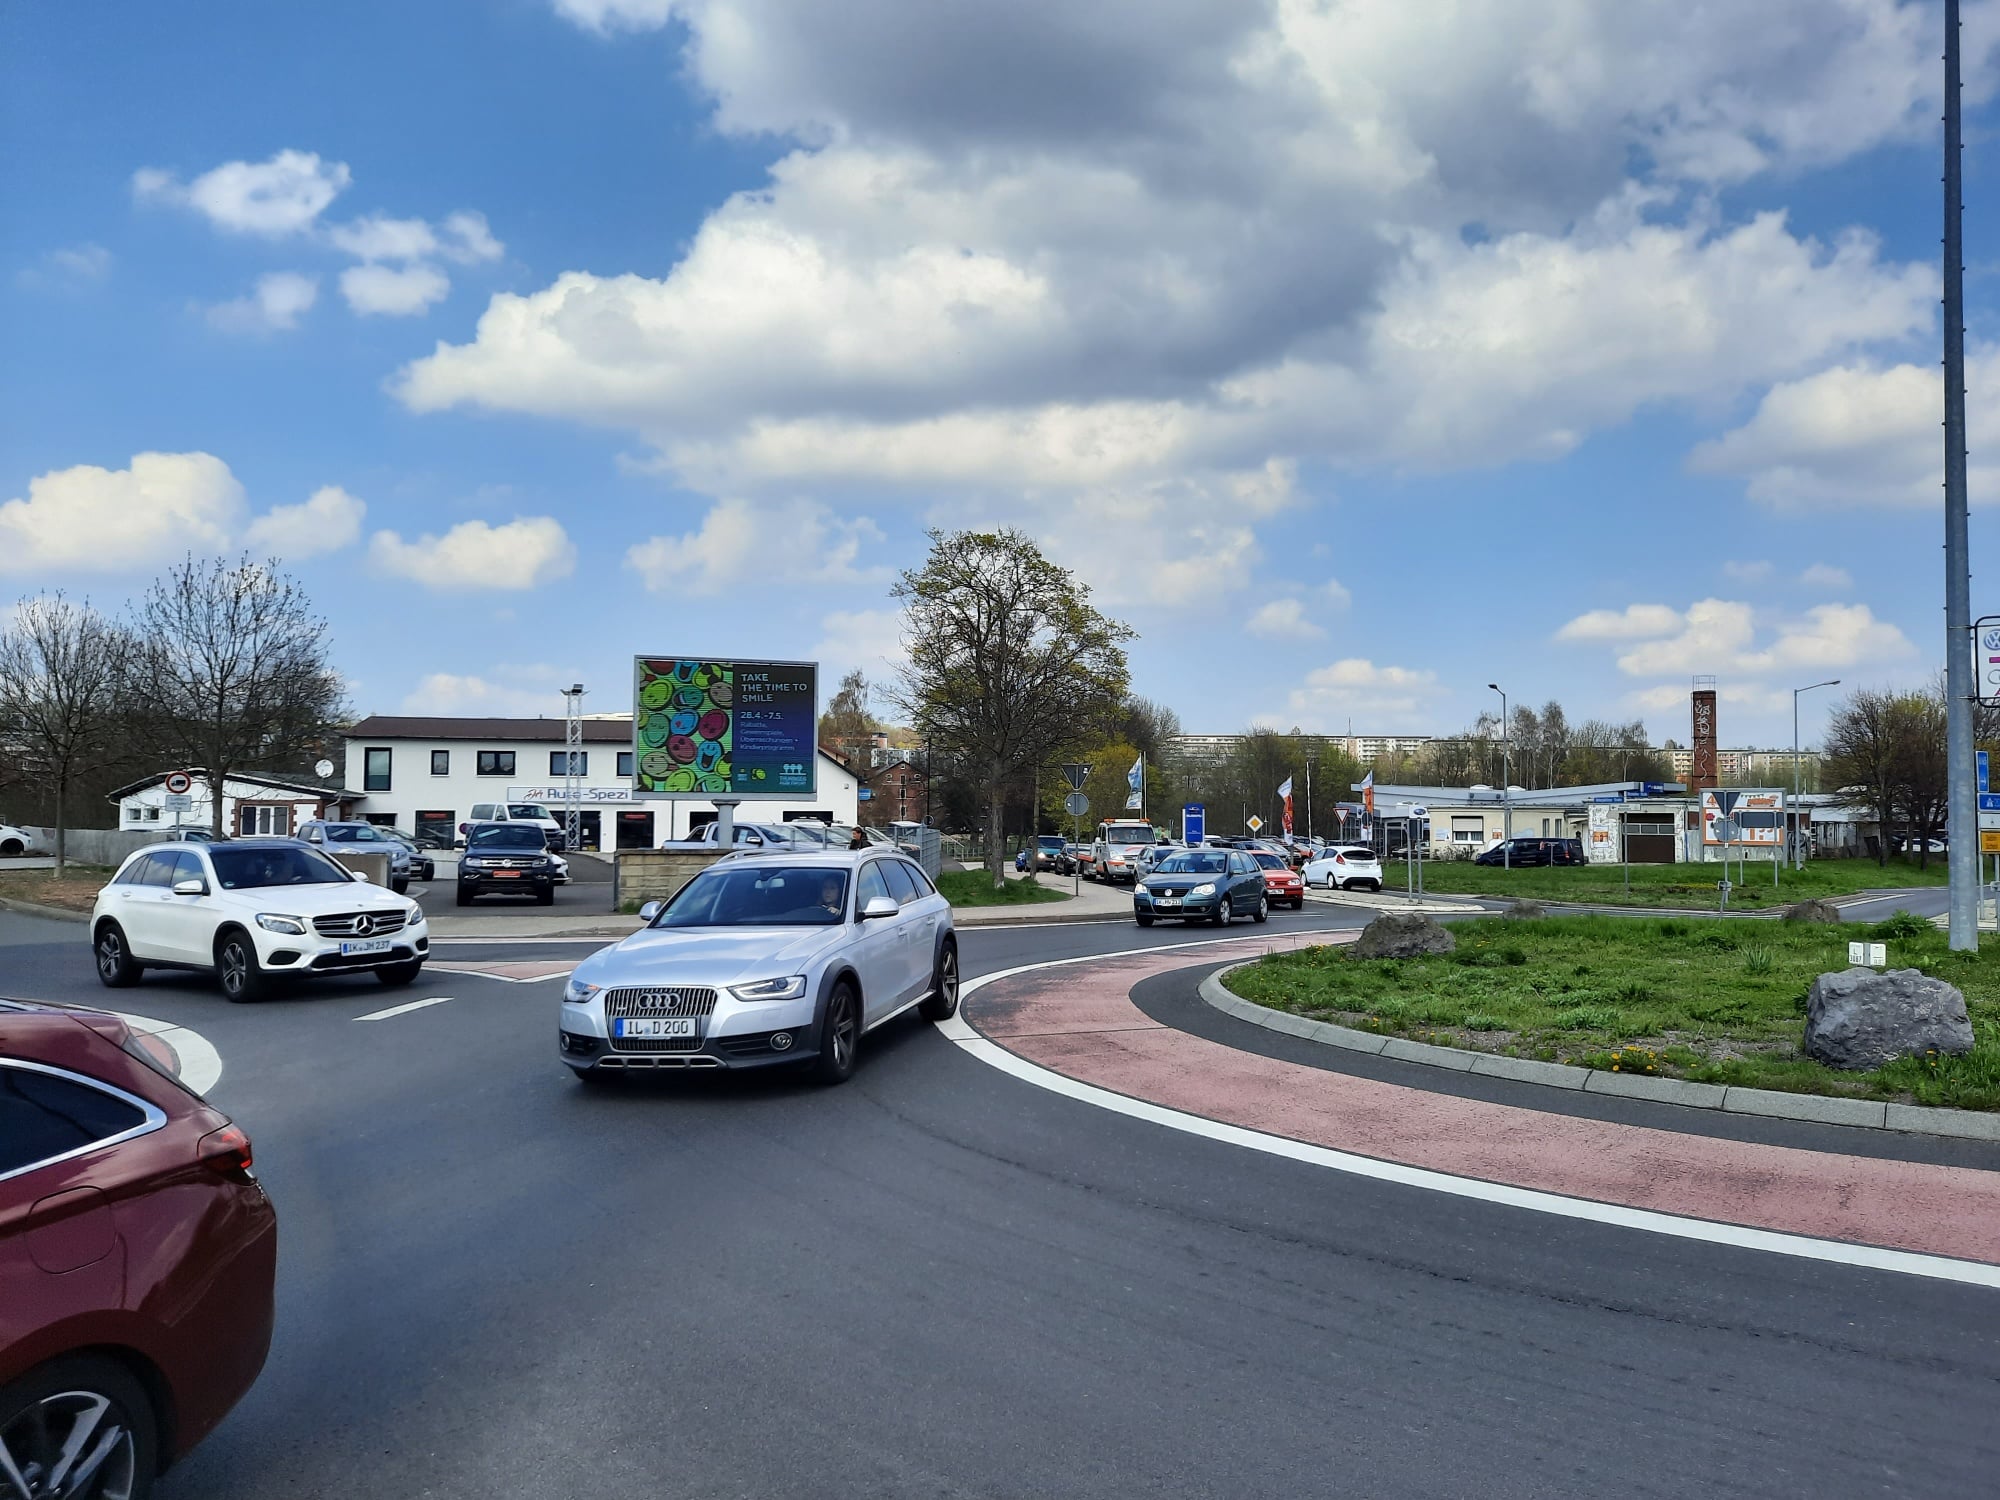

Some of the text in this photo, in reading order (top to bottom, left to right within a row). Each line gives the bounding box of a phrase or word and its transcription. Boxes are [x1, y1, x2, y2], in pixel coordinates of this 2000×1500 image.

[741, 673, 769, 682] TAKE
[741, 683, 808, 692] THE TIME TO
[742, 693, 774, 703] SMILE
[375, 941, 390, 950] 237
[628, 1020, 689, 1035] IL D 200
